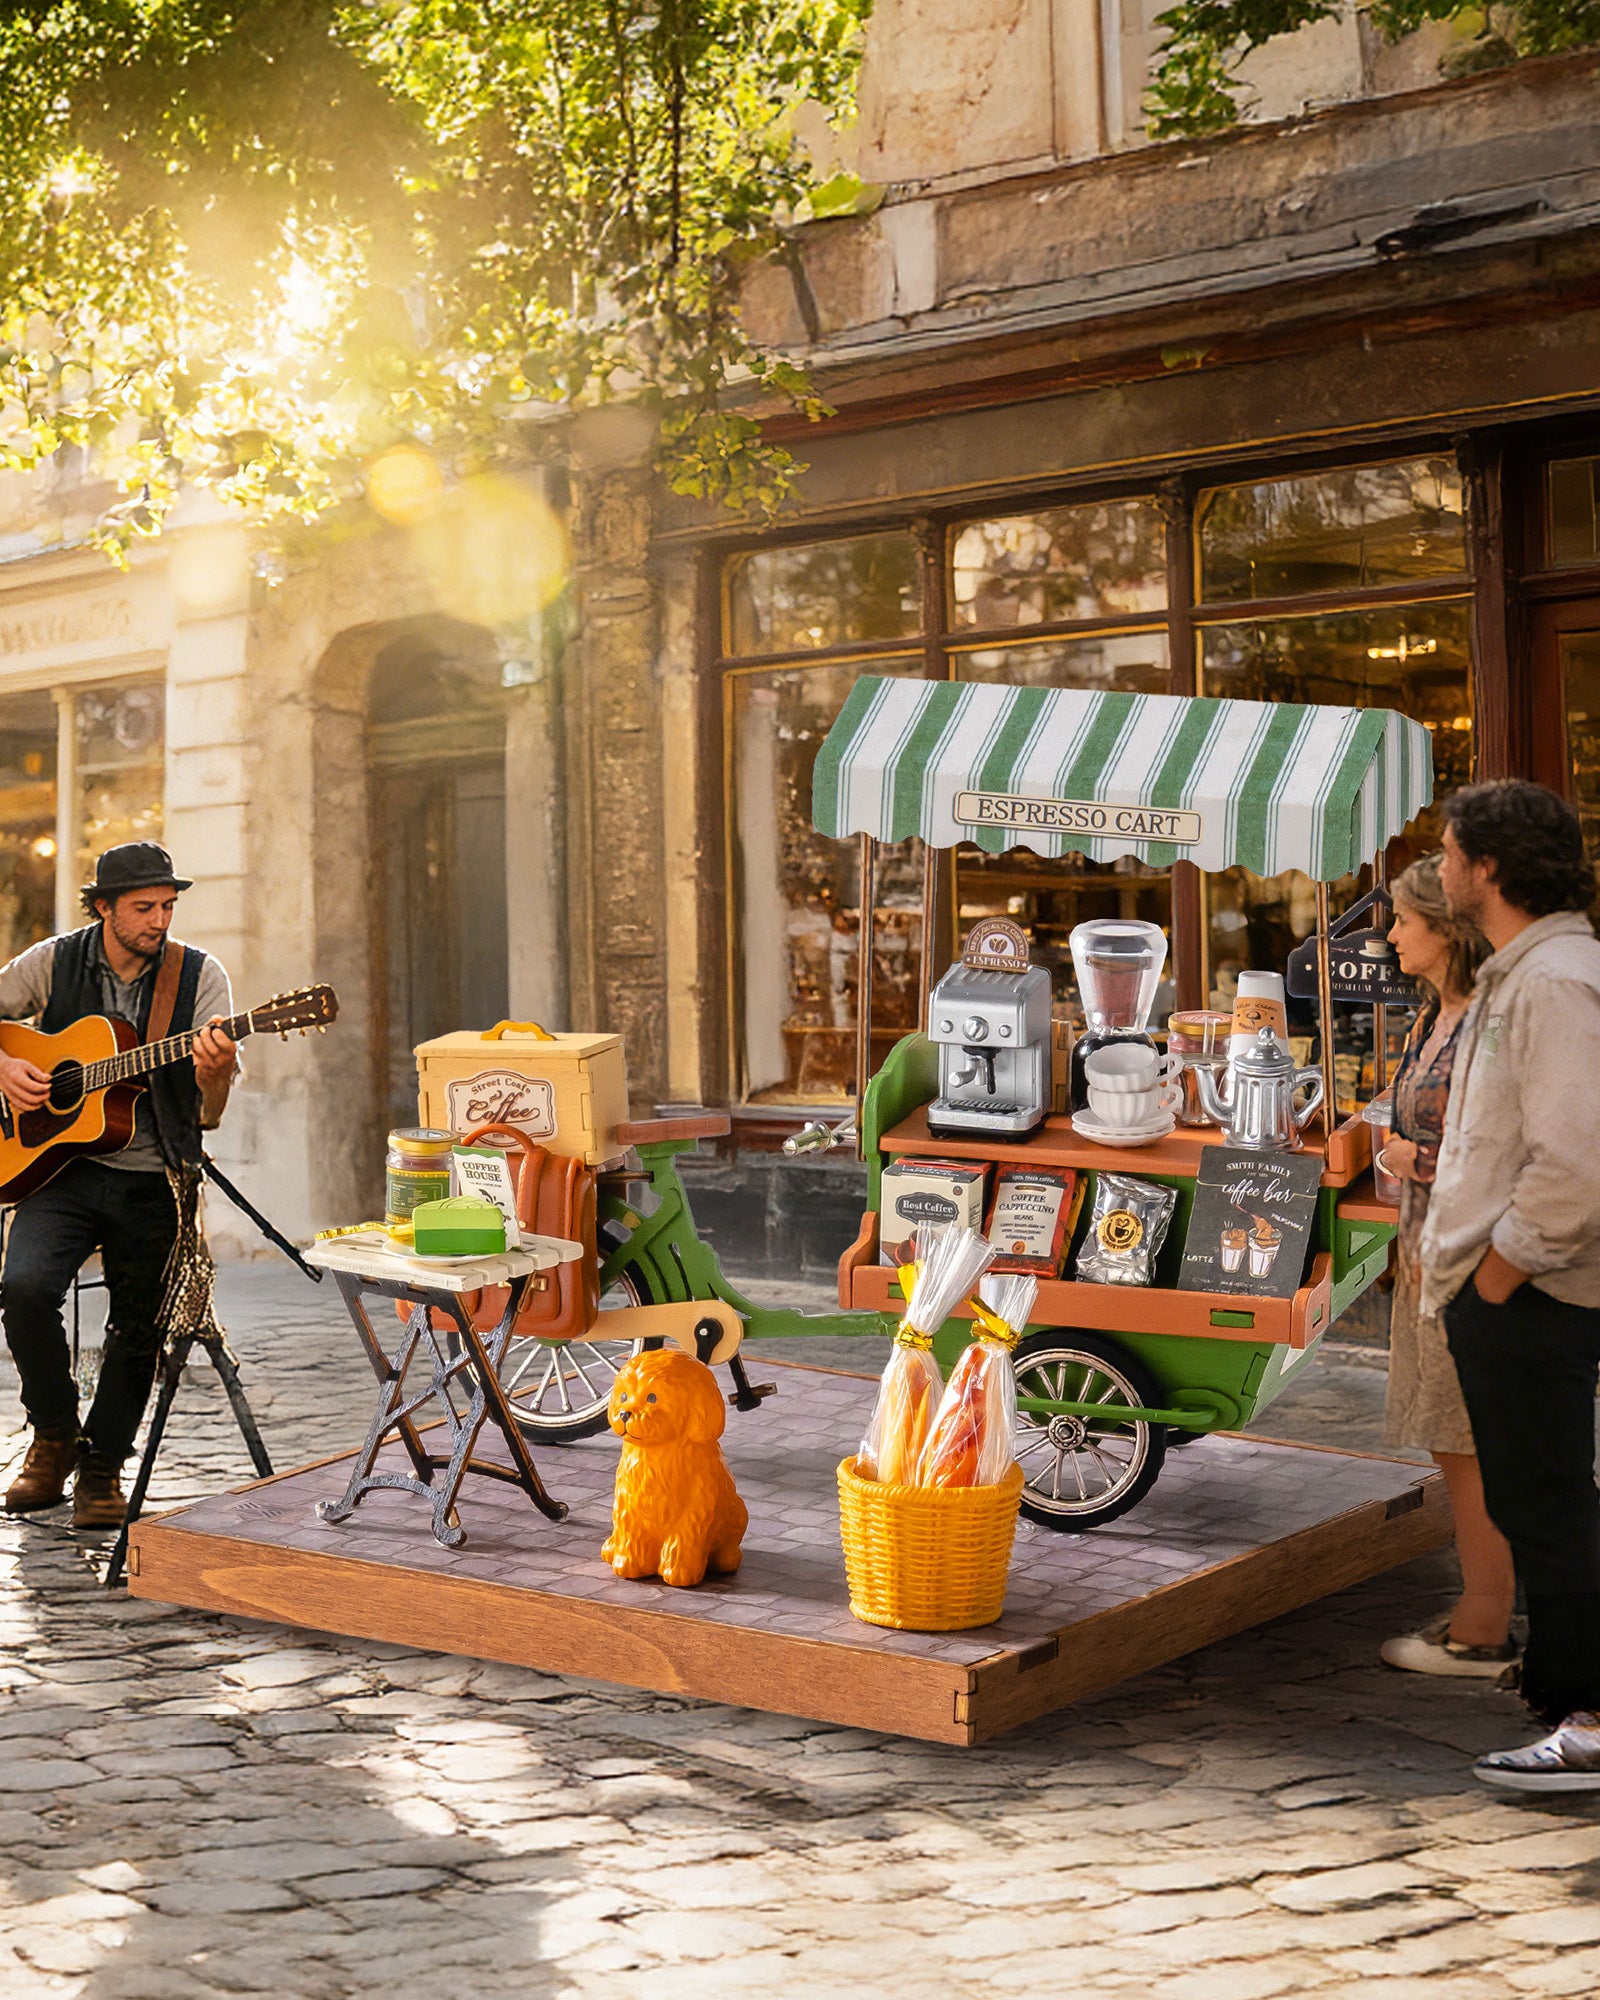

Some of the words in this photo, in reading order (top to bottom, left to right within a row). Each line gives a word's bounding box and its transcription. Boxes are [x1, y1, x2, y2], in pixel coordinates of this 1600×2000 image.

[977, 798, 1106, 828] ESPRESSO
[1116, 811, 1180, 836] CART
[973, 955, 1020, 968] ESPRESSO
[471, 1078, 501, 1095] Street
[466, 1091, 540, 1125] Coffee
[462, 1161, 501, 1173] COFFEE
[1226, 1161, 1255, 1171] SMITH
[1258, 1163, 1293, 1178] FAMILY
[464, 1169, 502, 1183] HOUSE
[1011, 1194, 1047, 1203] COFFEE
[1221, 1178, 1261, 1205] coffee
[1263, 1178, 1293, 1204] bar
[902, 1199, 923, 1211] Best
[924, 1201, 954, 1214] Coffee
[998, 1203, 1055, 1215] CAPPUCCINO
